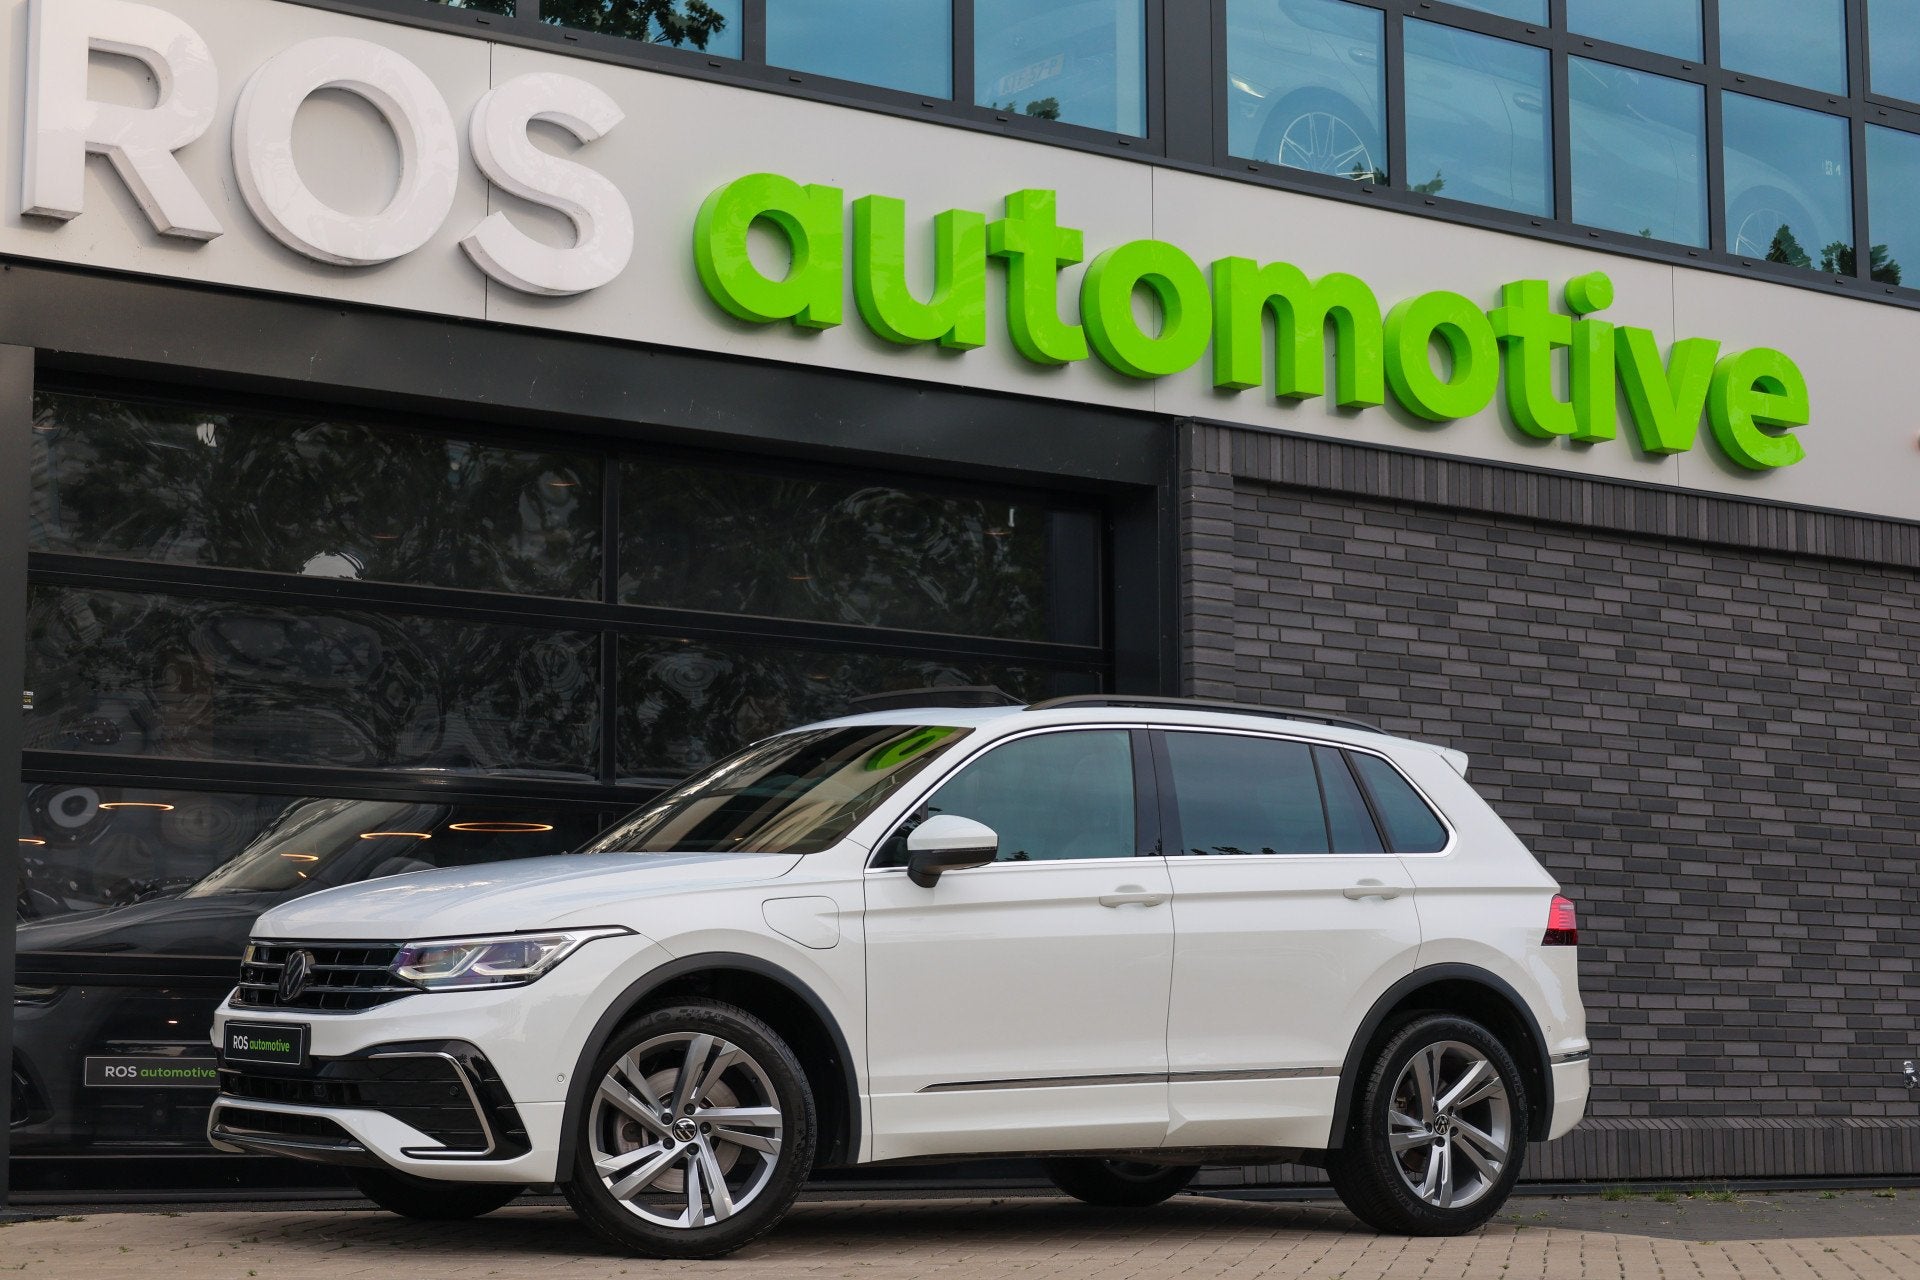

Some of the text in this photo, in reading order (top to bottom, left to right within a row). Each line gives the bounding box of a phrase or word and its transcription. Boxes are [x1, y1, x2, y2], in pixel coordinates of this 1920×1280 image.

[21, 0, 1810, 470] ROS automotive
[233, 1035, 290, 1052] ROS automotive
[105, 1065, 217, 1078] ROS automotive
